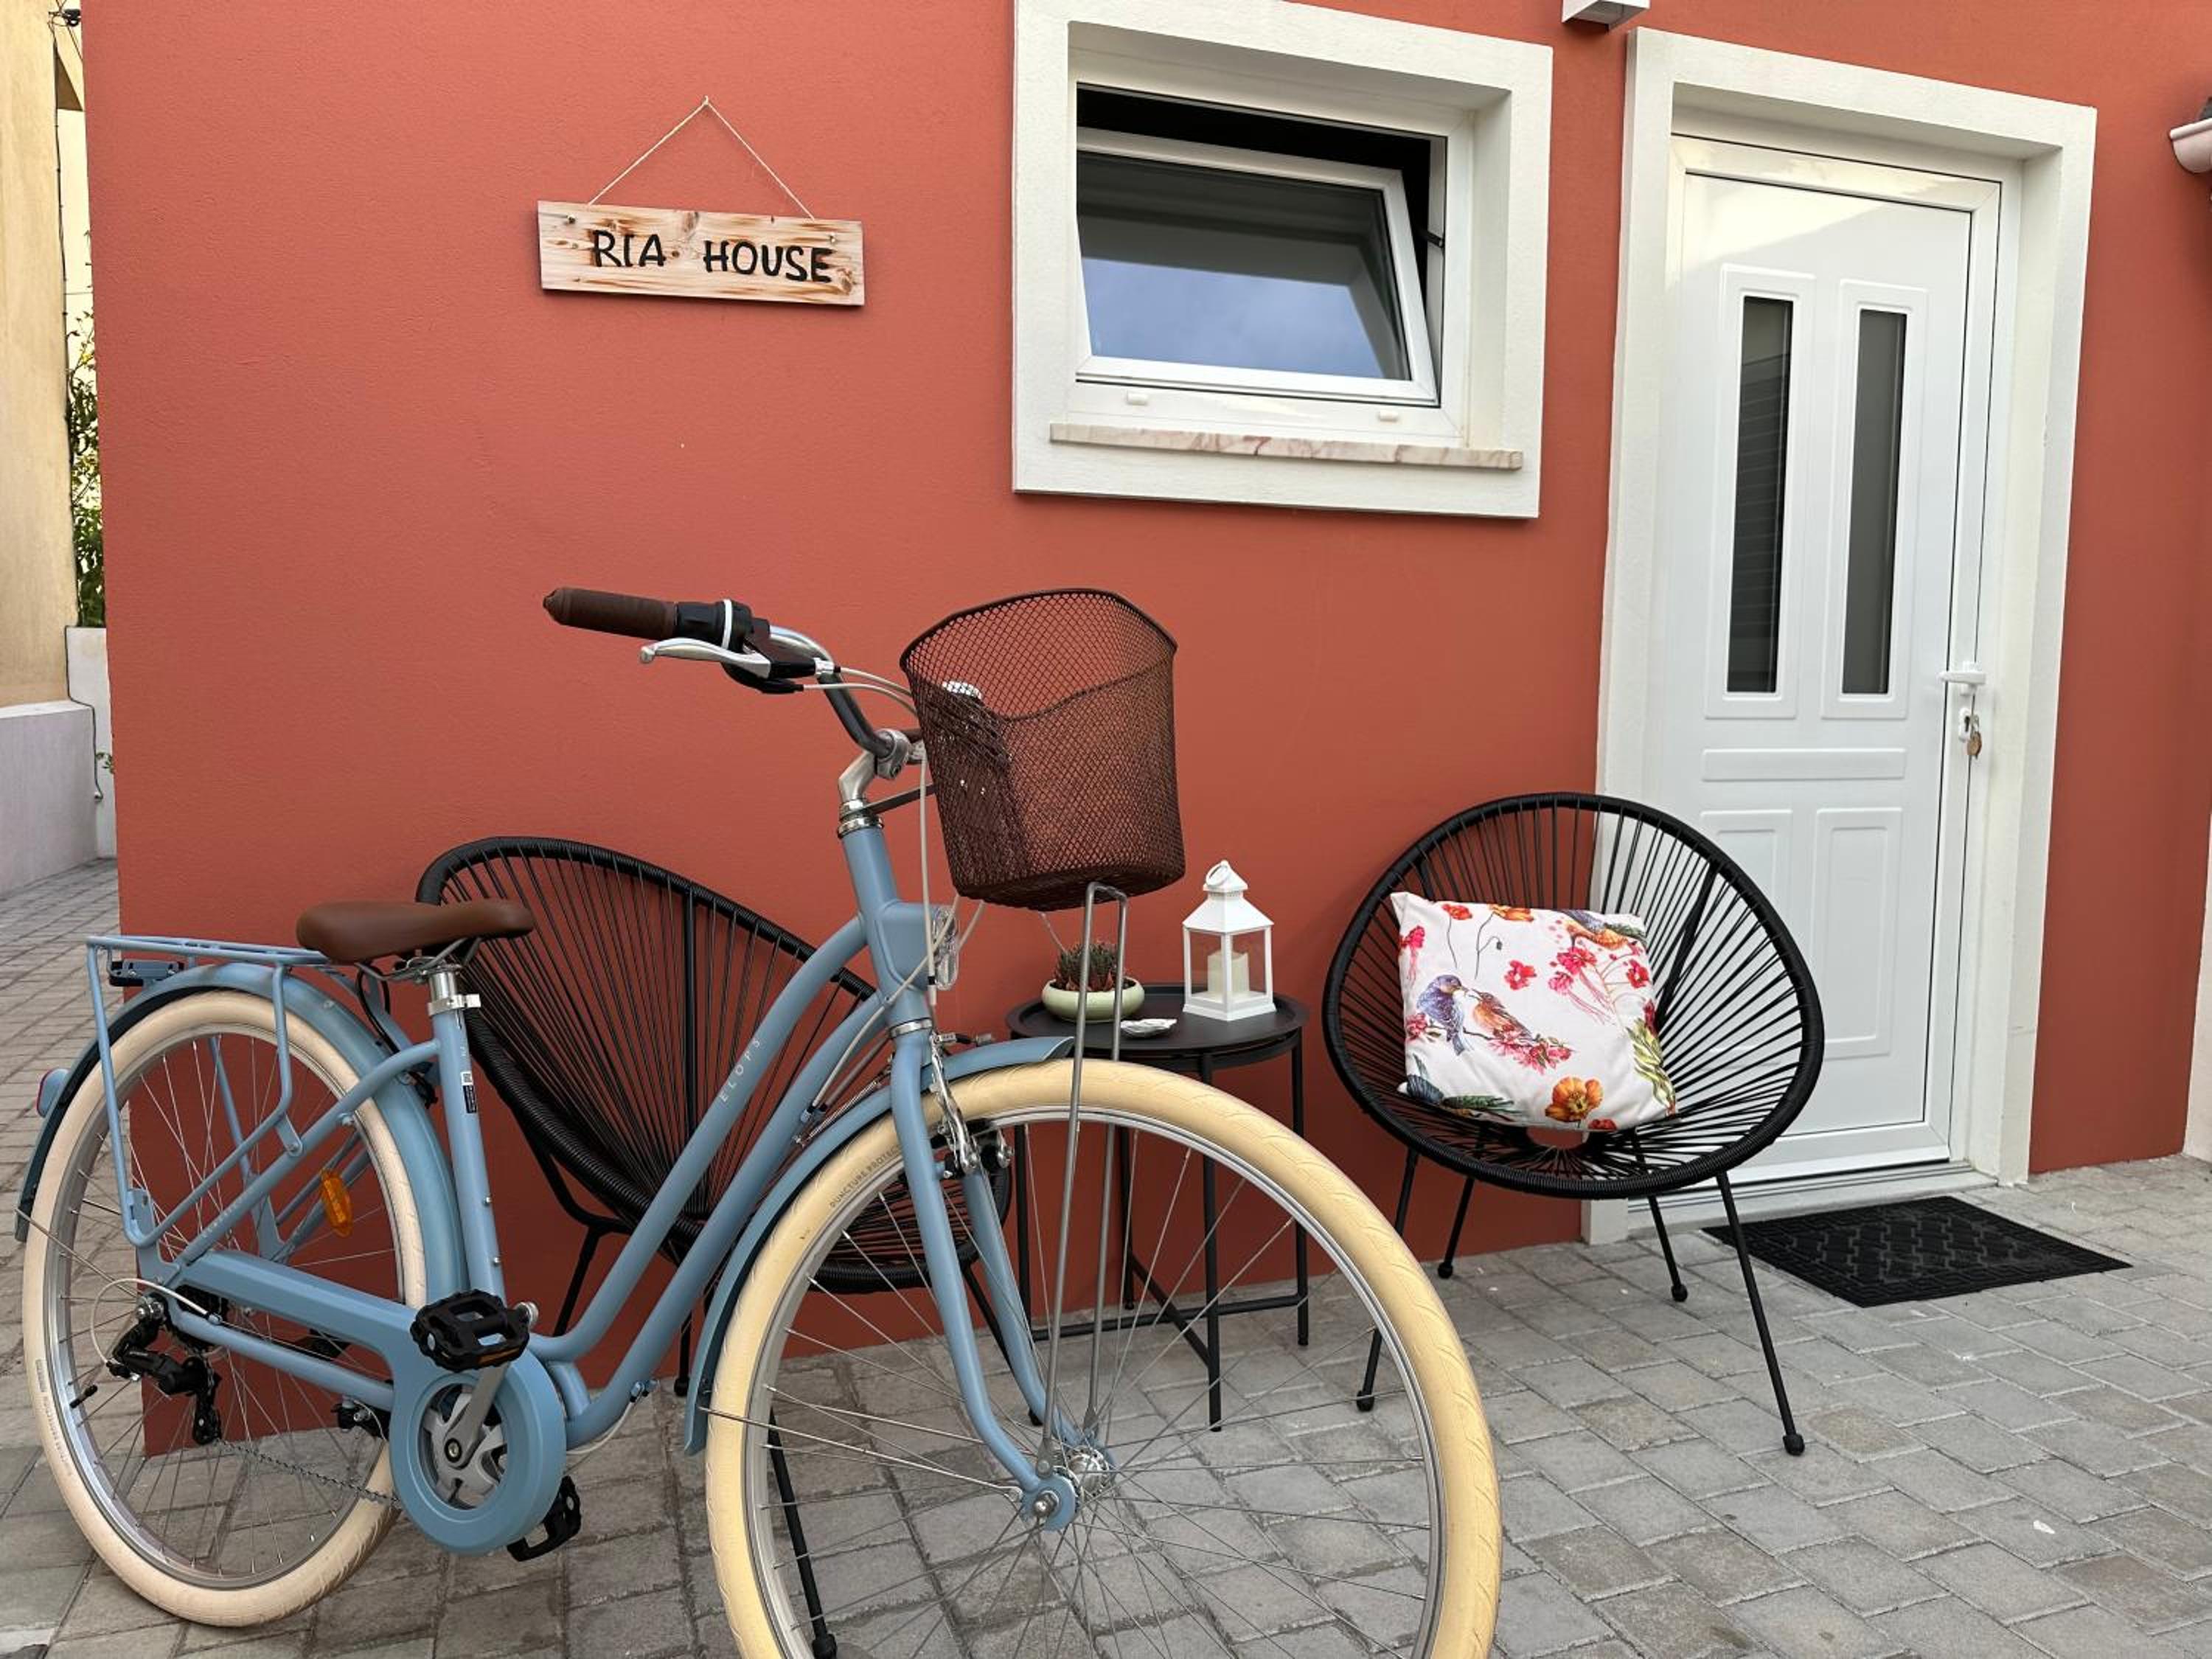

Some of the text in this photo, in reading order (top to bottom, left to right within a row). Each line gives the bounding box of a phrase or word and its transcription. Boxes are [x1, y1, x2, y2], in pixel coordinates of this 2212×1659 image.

[592, 229, 836, 283] RIA HOUSE
[830, 1169, 868, 1208] PUNCTURE
